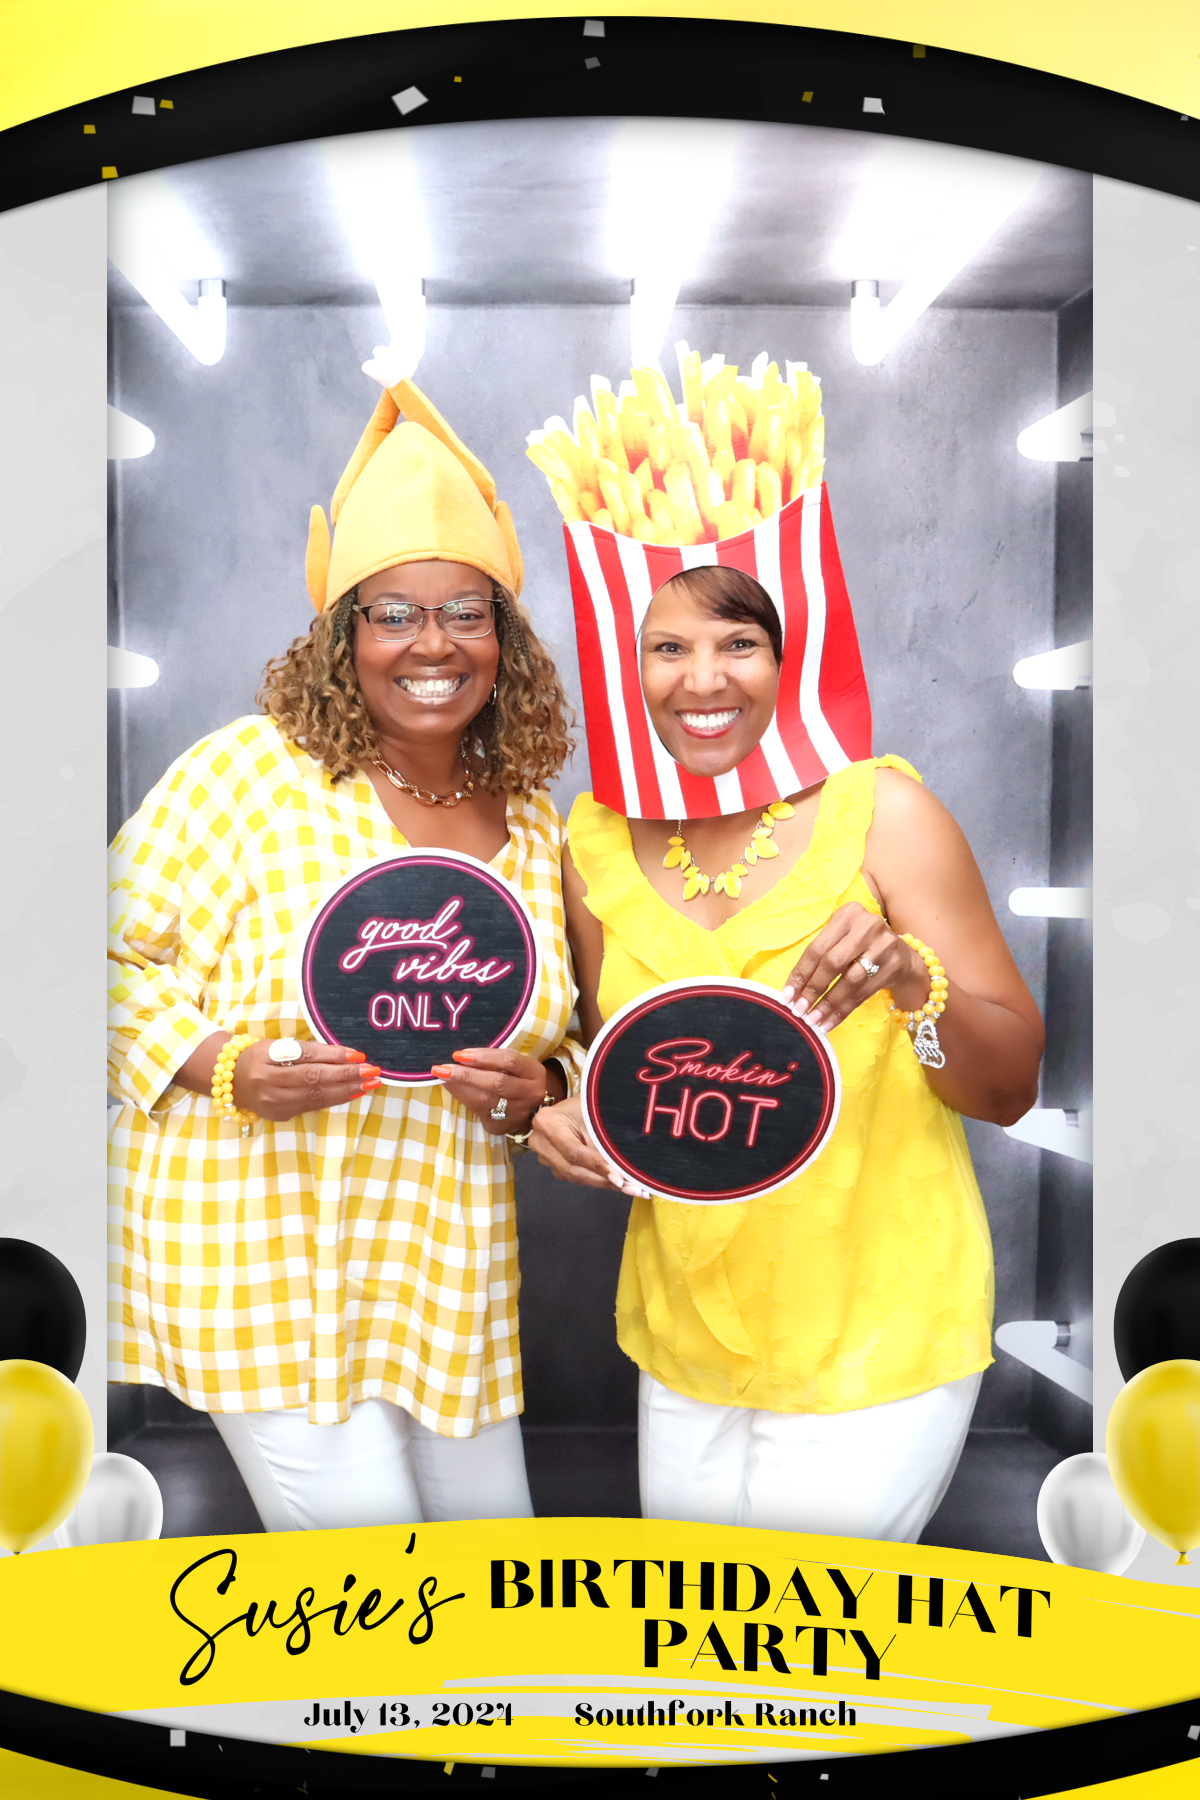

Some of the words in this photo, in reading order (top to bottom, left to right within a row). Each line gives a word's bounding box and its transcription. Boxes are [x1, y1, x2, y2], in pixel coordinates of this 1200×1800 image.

[341, 898, 461, 971] good
[395, 938, 512, 984] vibes
[370, 993, 470, 1029] ONLY
[637, 1038, 798, 1086] Smokin'
[644, 1084, 780, 1147] HOT
